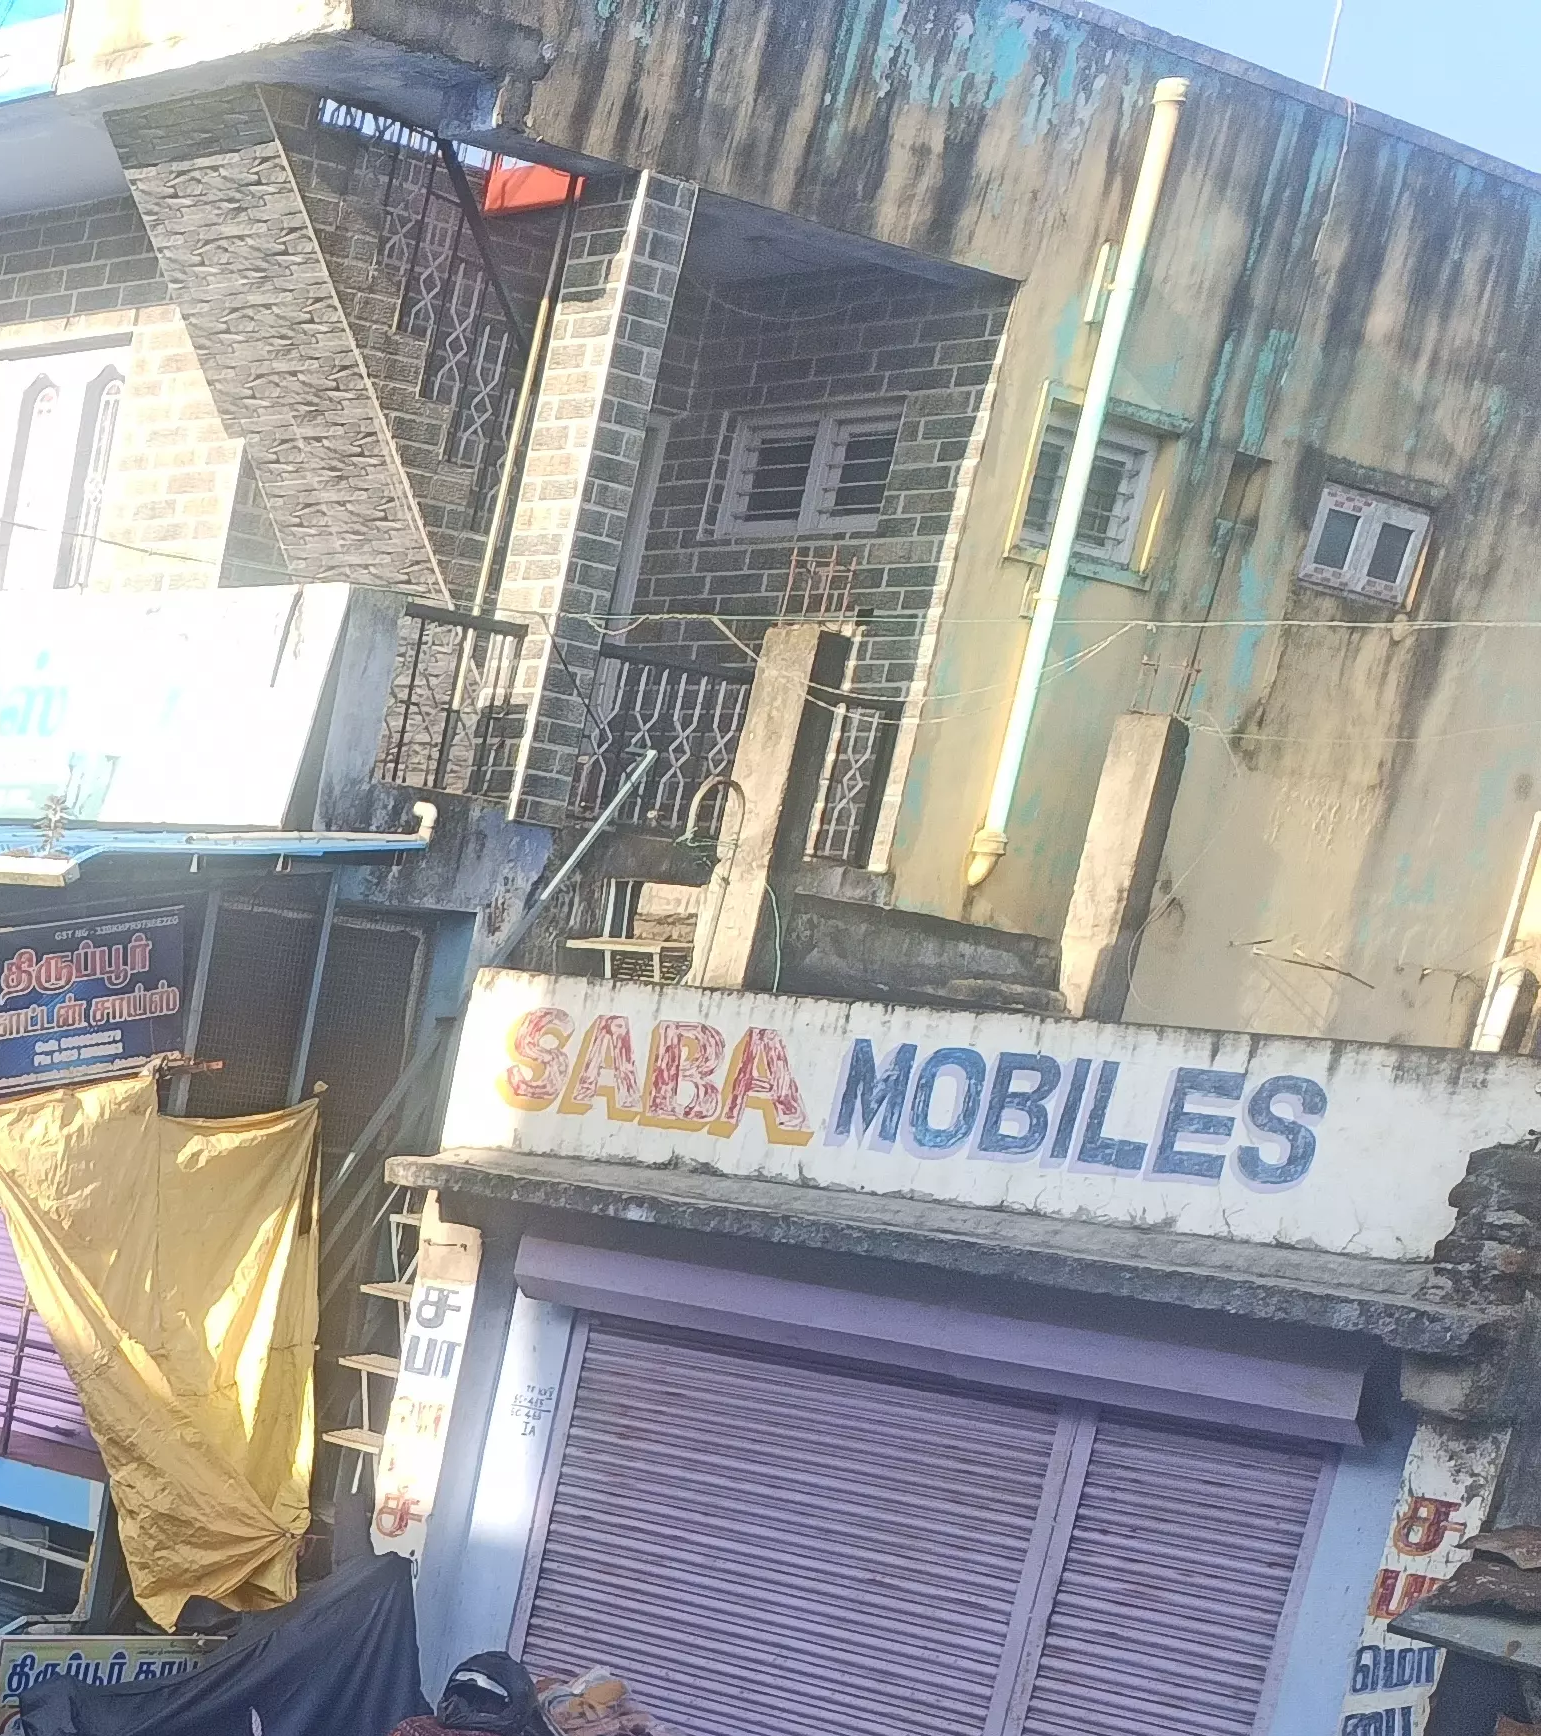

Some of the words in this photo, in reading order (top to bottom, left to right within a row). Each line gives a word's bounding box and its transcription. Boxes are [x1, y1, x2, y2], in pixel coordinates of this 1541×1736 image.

[0, 933, 152, 1005] திருப்பூர்
[90, 980, 179, 1025] சாய்ஸ்
[494, 1007, 814, 1148] SABA
[825, 1036, 1328, 1194] MOBILES
